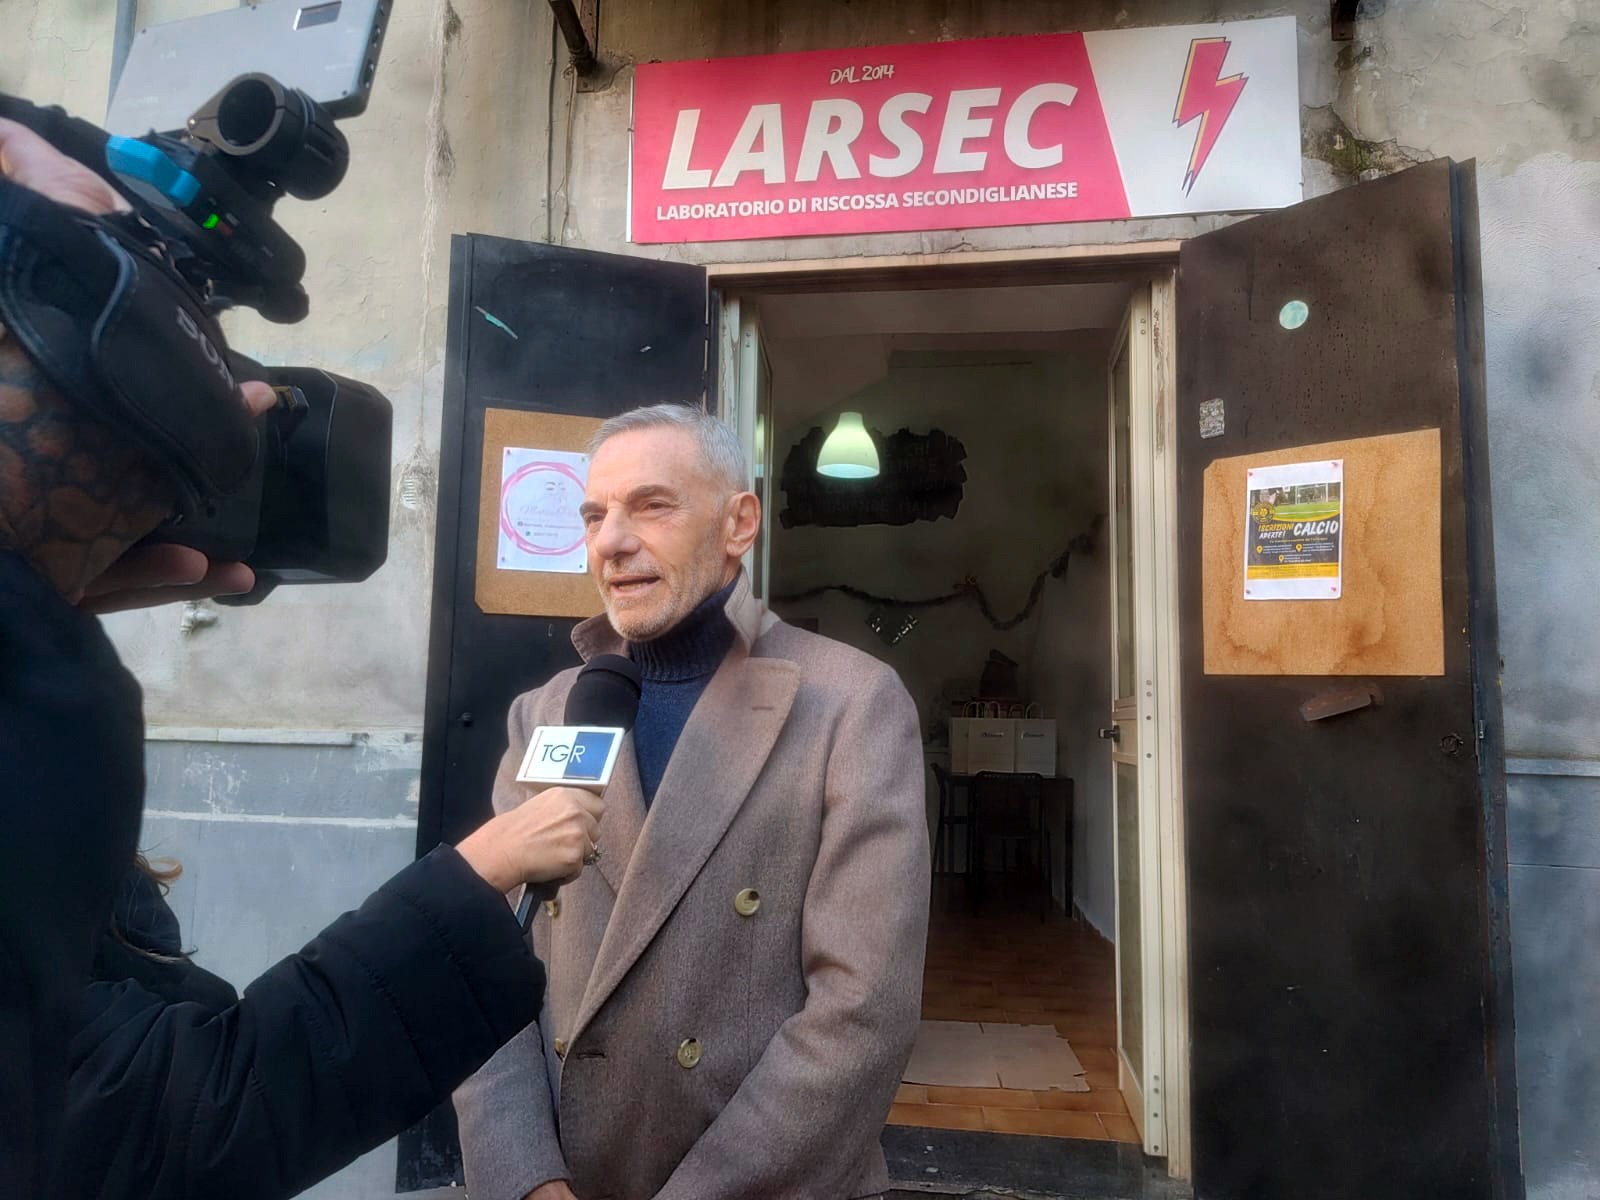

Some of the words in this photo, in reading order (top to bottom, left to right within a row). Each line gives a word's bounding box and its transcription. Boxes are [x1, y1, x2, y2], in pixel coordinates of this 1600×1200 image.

[829, 67, 860, 85] DAL
[862, 65, 894, 81] 2014
[661, 82, 1079, 190] LARSEC
[656, 199, 784, 221] LABORATORIO
[788, 198, 807, 213] DI
[811, 193, 899, 213] RISCOSSA
[902, 182, 1078, 207] SECONDIGLIANESE
[1293, 520, 1339, 536] CALCIO
[541, 744, 586, 763] TGR
